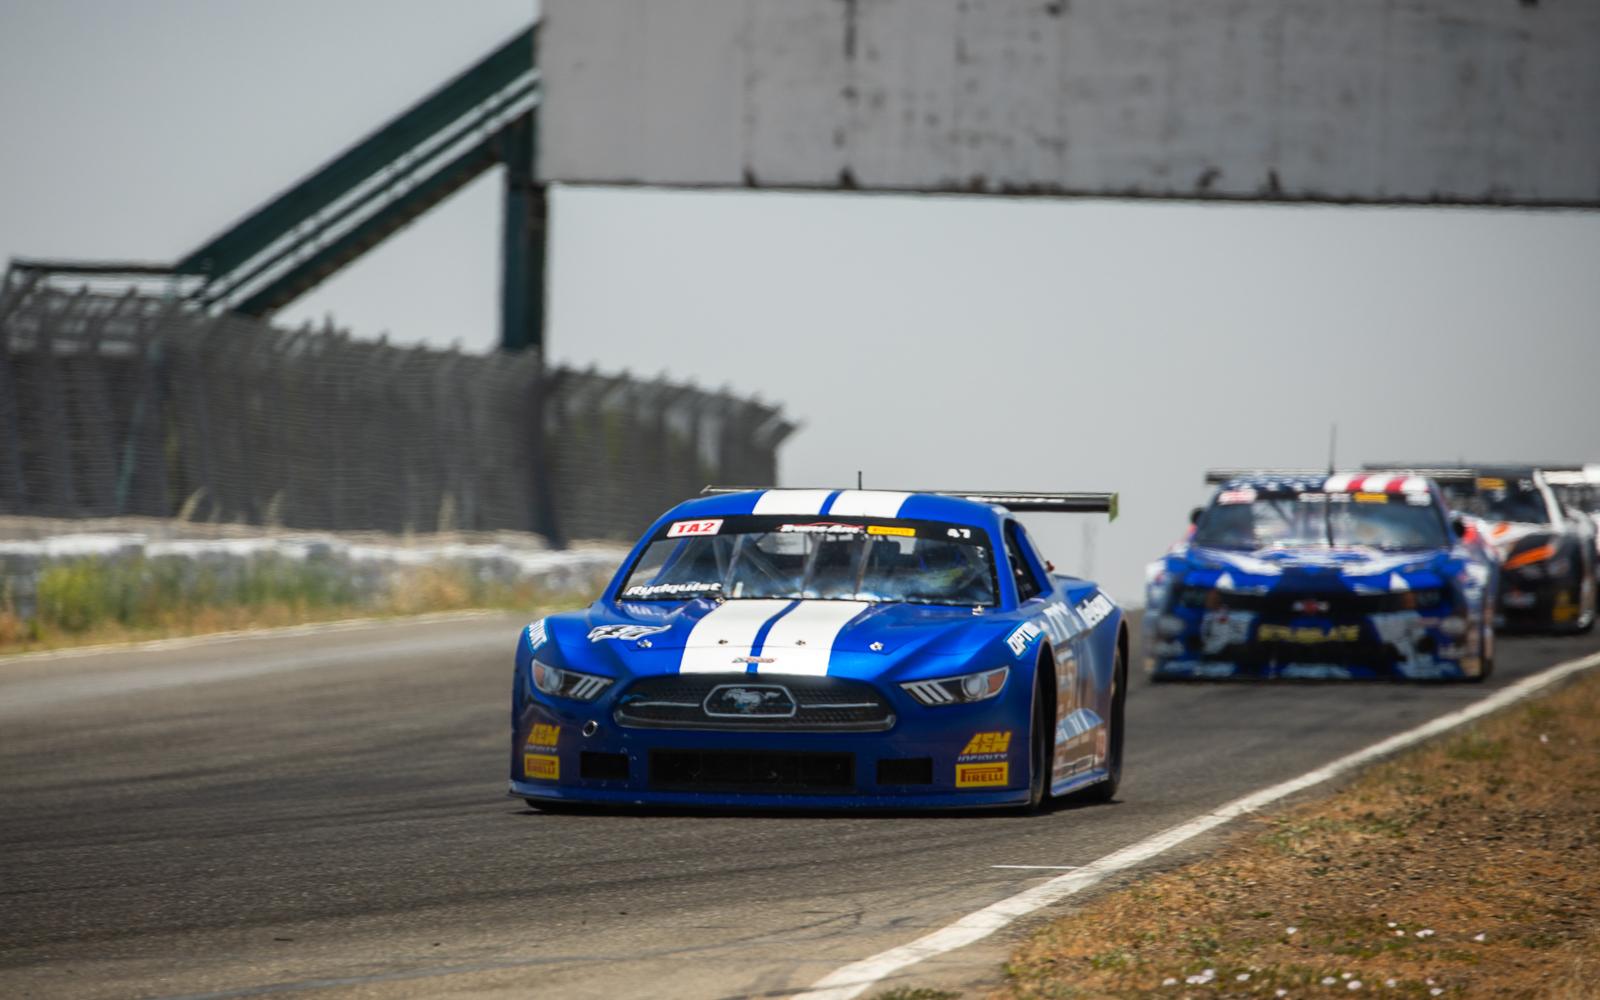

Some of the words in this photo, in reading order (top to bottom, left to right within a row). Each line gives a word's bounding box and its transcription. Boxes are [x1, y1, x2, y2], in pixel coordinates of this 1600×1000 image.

[677, 522, 715, 533] TA2
[961, 731, 1011, 754] AEM
[961, 767, 1004, 783] PIRELLI
